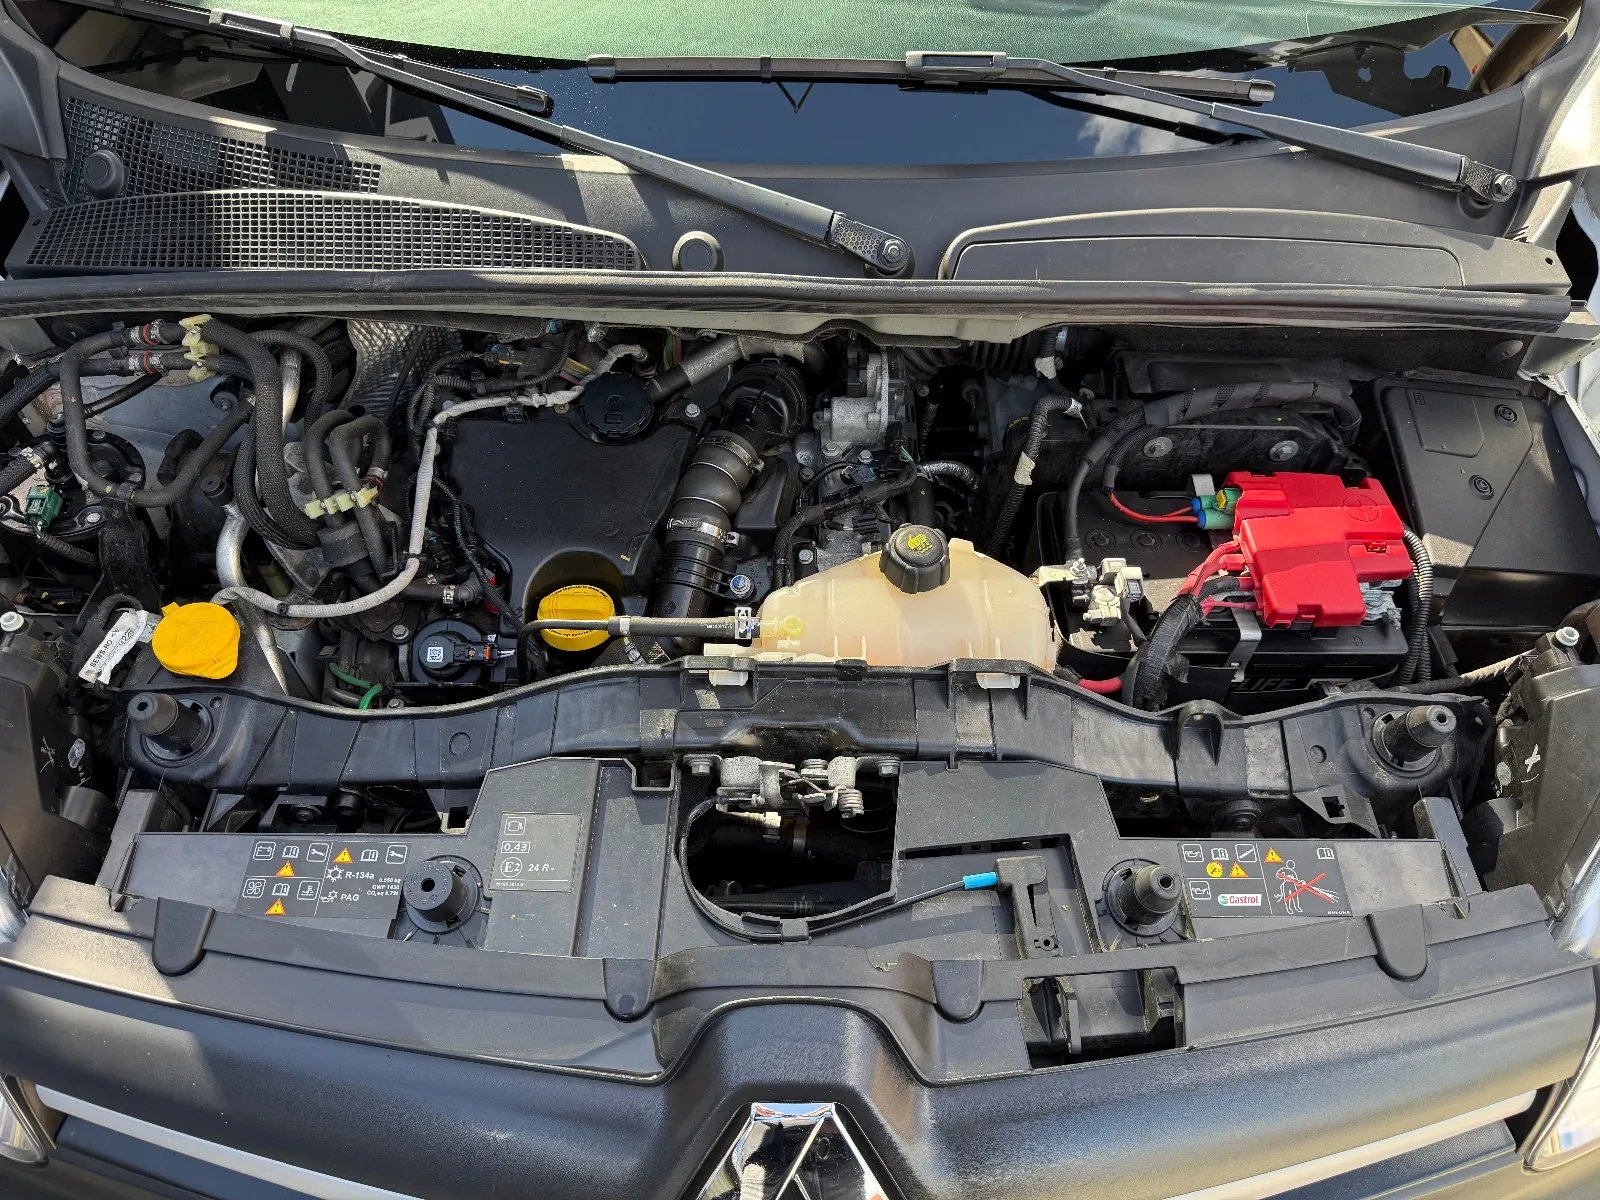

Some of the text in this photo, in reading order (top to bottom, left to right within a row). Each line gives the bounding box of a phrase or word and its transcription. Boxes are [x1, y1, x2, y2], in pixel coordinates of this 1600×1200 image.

[503, 843, 528, 852] 0,43
[503, 861, 521, 873] E2
[528, 863, 540, 872] 24
[345, 871, 375, 880] R-134a
[340, 893, 360, 902] PAG
[1229, 895, 1259, 904] Castrol
